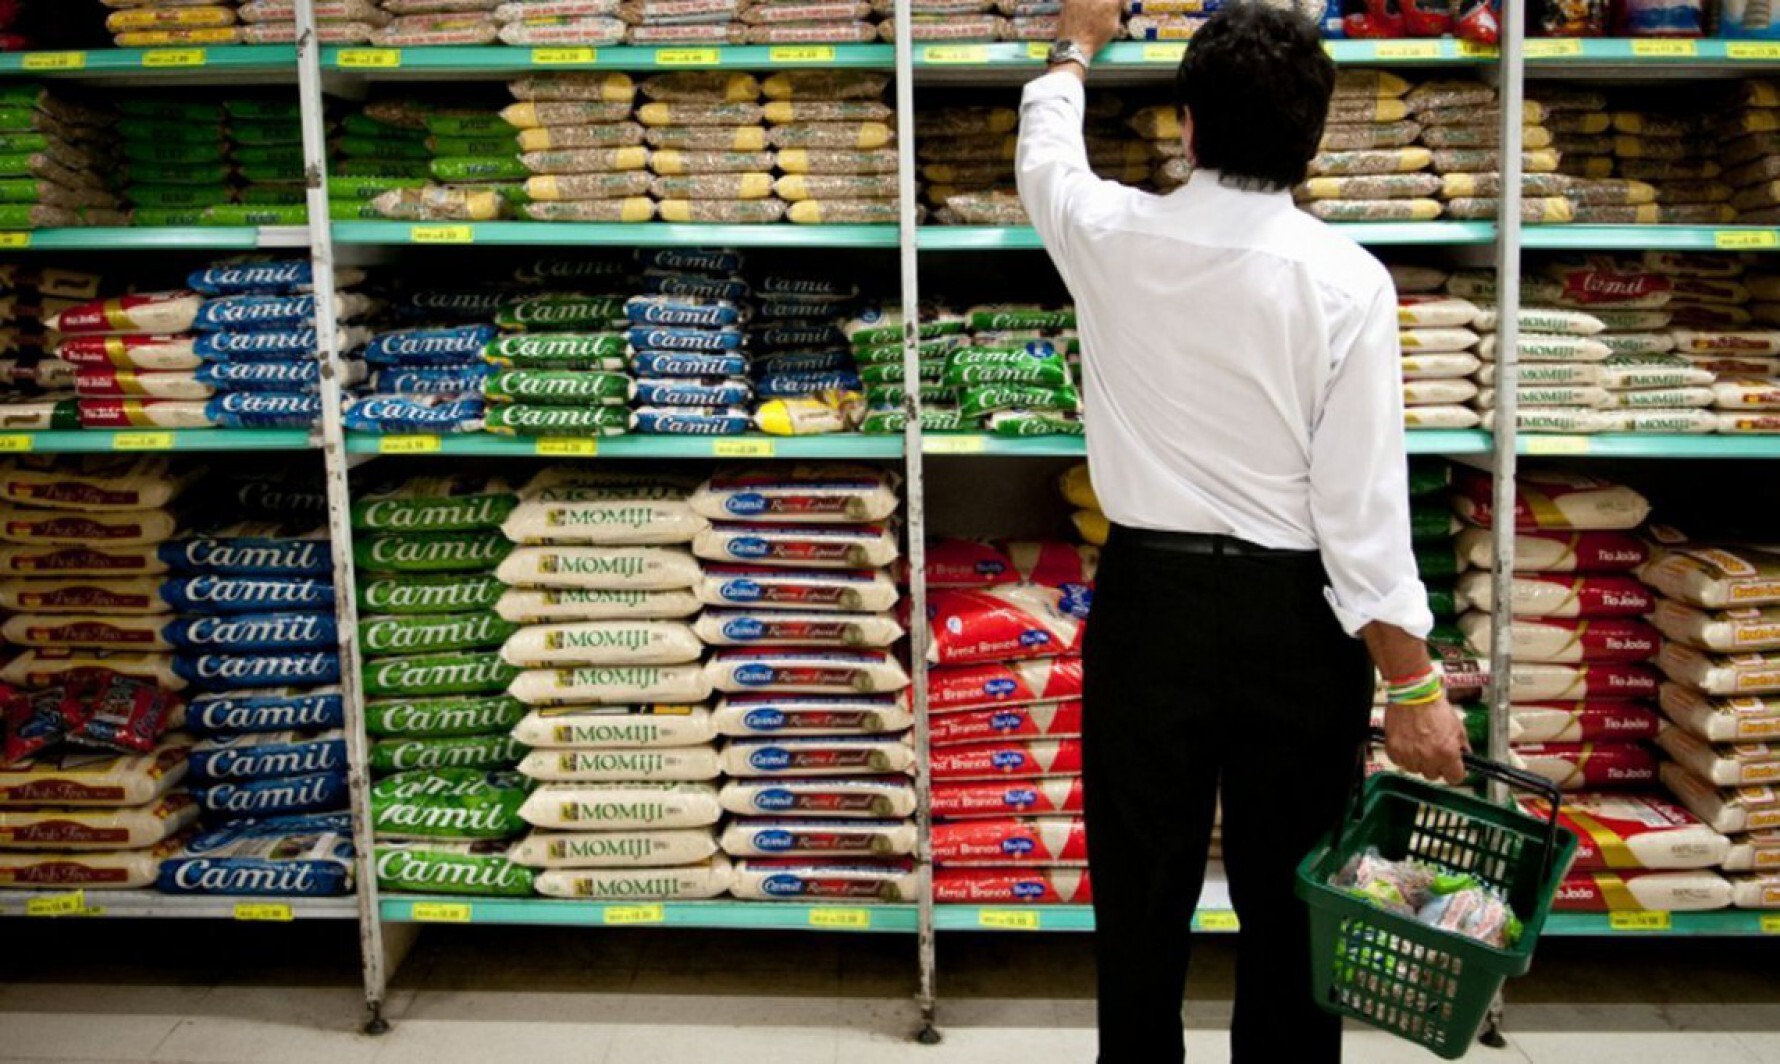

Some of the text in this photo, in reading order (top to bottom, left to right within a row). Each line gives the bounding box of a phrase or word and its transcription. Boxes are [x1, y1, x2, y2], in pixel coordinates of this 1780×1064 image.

[654, 250, 726, 271] Camil
[204, 261, 300, 284] Camil
[659, 276, 732, 298] Camil
[206, 297, 313, 323] Camil
[514, 301, 613, 322] Camil
[644, 305, 721, 325] Camil
[210, 327, 317, 350] Camil
[381, 332, 480, 354] Camil
[499, 334, 606, 357] Camil
[647, 330, 724, 349] Camil
[210, 357, 316, 380] Camil
[652, 355, 729, 374] Camil
[962, 365, 1041, 382] Camil
[500, 370, 605, 394] Camil
[650, 384, 728, 405] Camil
[502, 404, 607, 426] Camil
[653, 412, 731, 434] Camil
[364, 498, 497, 528] Camil
[567, 507, 653, 529] MOMIJI
[185, 538, 318, 567] Camil
[371, 531, 500, 562] Camil
[1598, 551, 1613, 562] Tio
[560, 556, 644, 578] MOMIJI
[185, 575, 319, 601] Camil
[364, 575, 495, 607] Camil
[1602, 592, 1647, 607] Tio João
[187, 616, 321, 644] Camil
[366, 616, 497, 650] Camil
[566, 629, 650, 650] MOMIJI
[1605, 636, 1651, 650] Tio João
[197, 652, 330, 677] Camil
[376, 655, 509, 688] Camil
[576, 667, 660, 689] MOMIJI
[1608, 675, 1625, 687] Tio
[202, 699, 331, 729] Camil
[381, 700, 512, 732] Camil
[1604, 718, 1621, 730] Tio
[575, 725, 659, 745] MOMIJI
[206, 742, 337, 772] Camil
[392, 737, 520, 770] Camil
[579, 753, 663, 775] MOMIJI
[1607, 768, 1624, 779] Tio
[206, 776, 330, 810] Camil
[582, 802, 664, 823] MOMIJI
[569, 838, 652, 860] MOMIJI
[932, 845, 957, 856] rroz
[174, 858, 315, 892] Camil
[376, 850, 518, 888] Camil
[596, 877, 679, 899] MOMIJI
